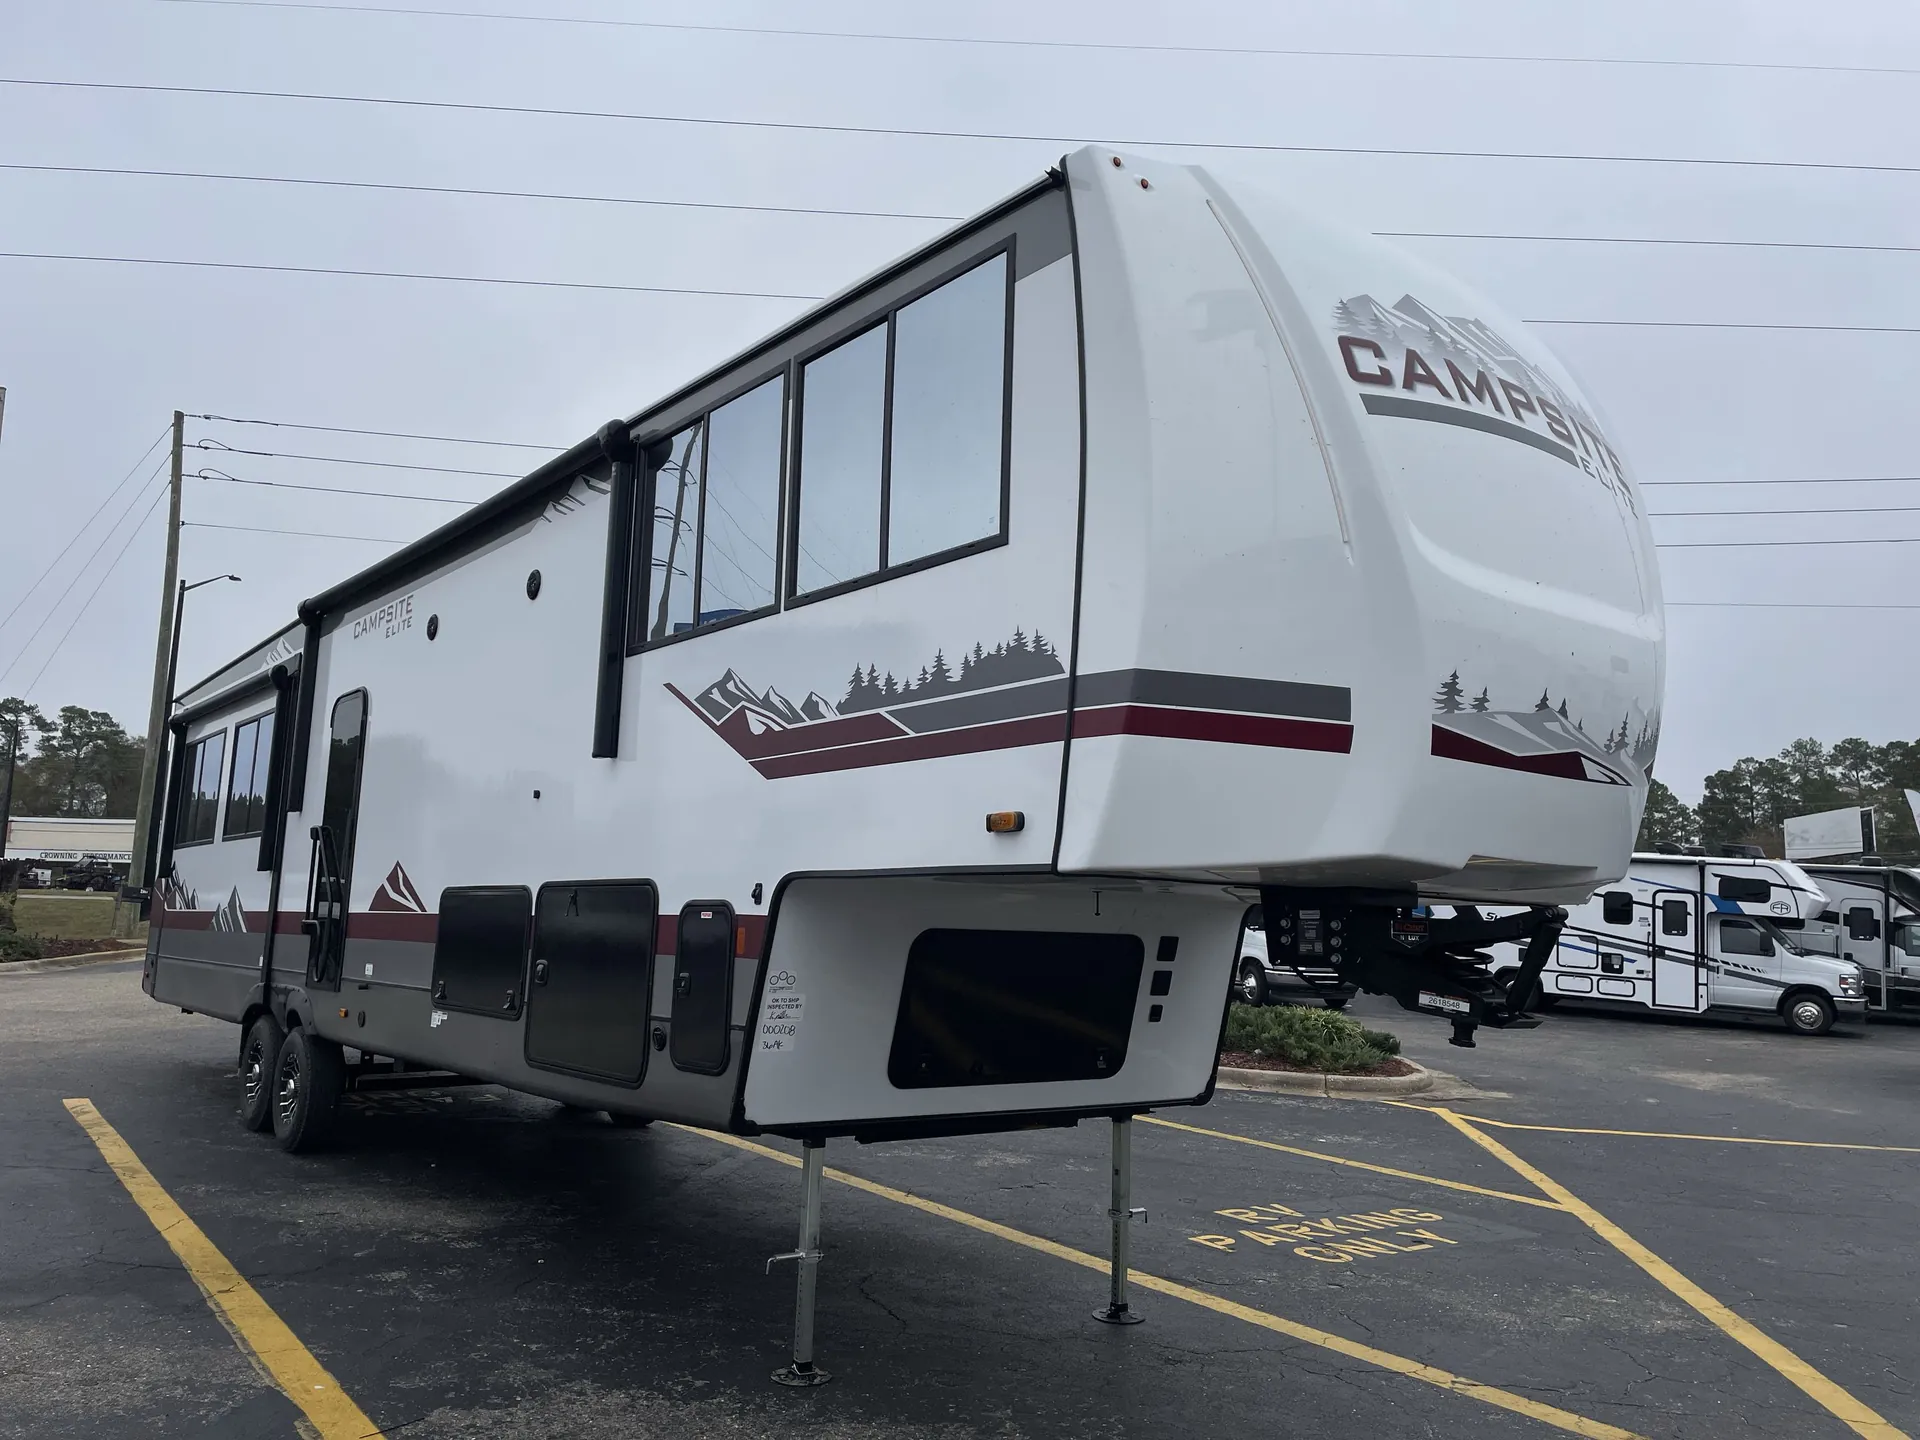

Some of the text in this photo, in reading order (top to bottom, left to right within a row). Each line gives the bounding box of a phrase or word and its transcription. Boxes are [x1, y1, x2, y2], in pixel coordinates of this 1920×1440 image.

[1338, 335, 1633, 499] CAMPSITE
[1579, 455, 1639, 520] ELITE
[353, 594, 414, 640] CAMPSITE
[385, 616, 413, 639] ELITE
[1428, 997, 1460, 1010] 2618548
[1188, 1208, 1444, 1253] PARKING
[1214, 1203, 1306, 1223] RV
[1293, 1228, 1459, 1263] ONLY
